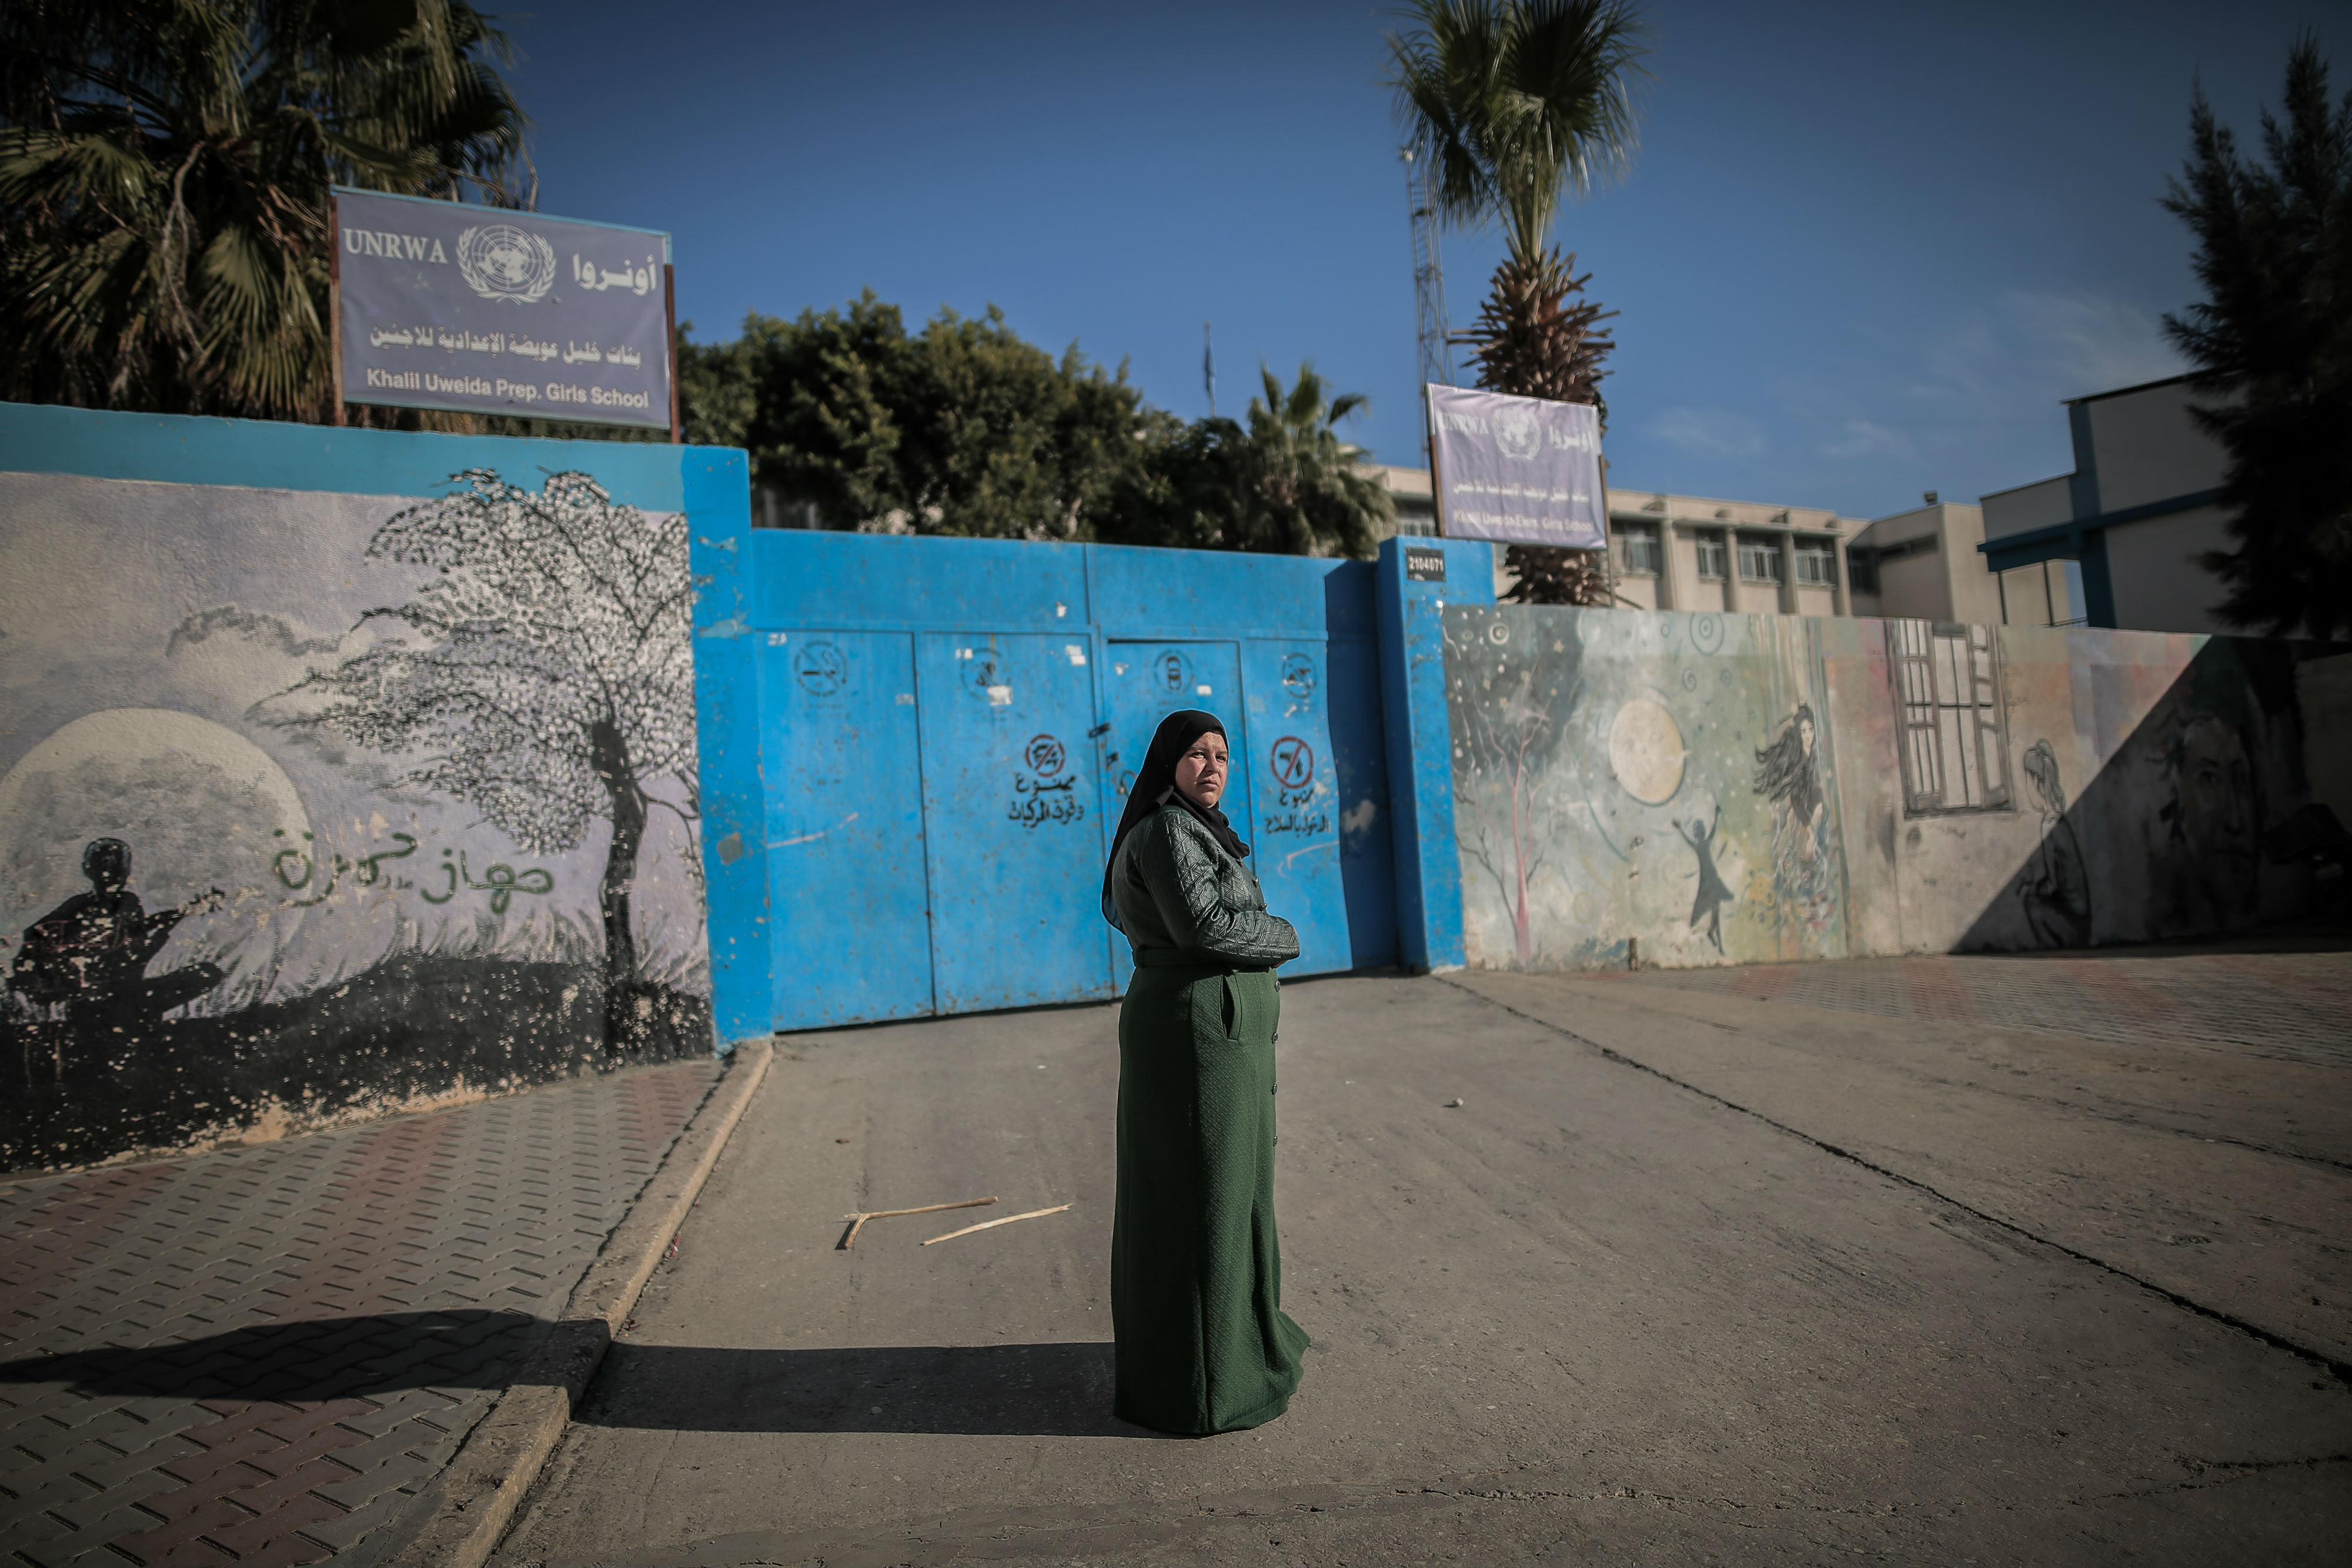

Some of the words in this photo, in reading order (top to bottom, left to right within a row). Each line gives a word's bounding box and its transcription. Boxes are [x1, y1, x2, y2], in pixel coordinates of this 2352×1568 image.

[343, 228, 448, 265] UNRWA
[572, 253, 657, 296] أونروا
[509, 333, 559, 362] عويضة
[562, 339, 602, 365] خليل
[606, 343, 642, 370] بنات
[366, 367, 420, 391] Khalil
[425, 372, 493, 396] Uweida
[496, 377, 542, 404] Prep.
[546, 382, 588, 404] Girls
[590, 385, 649, 409] School
[1441, 413, 1489, 434] UNRWA
